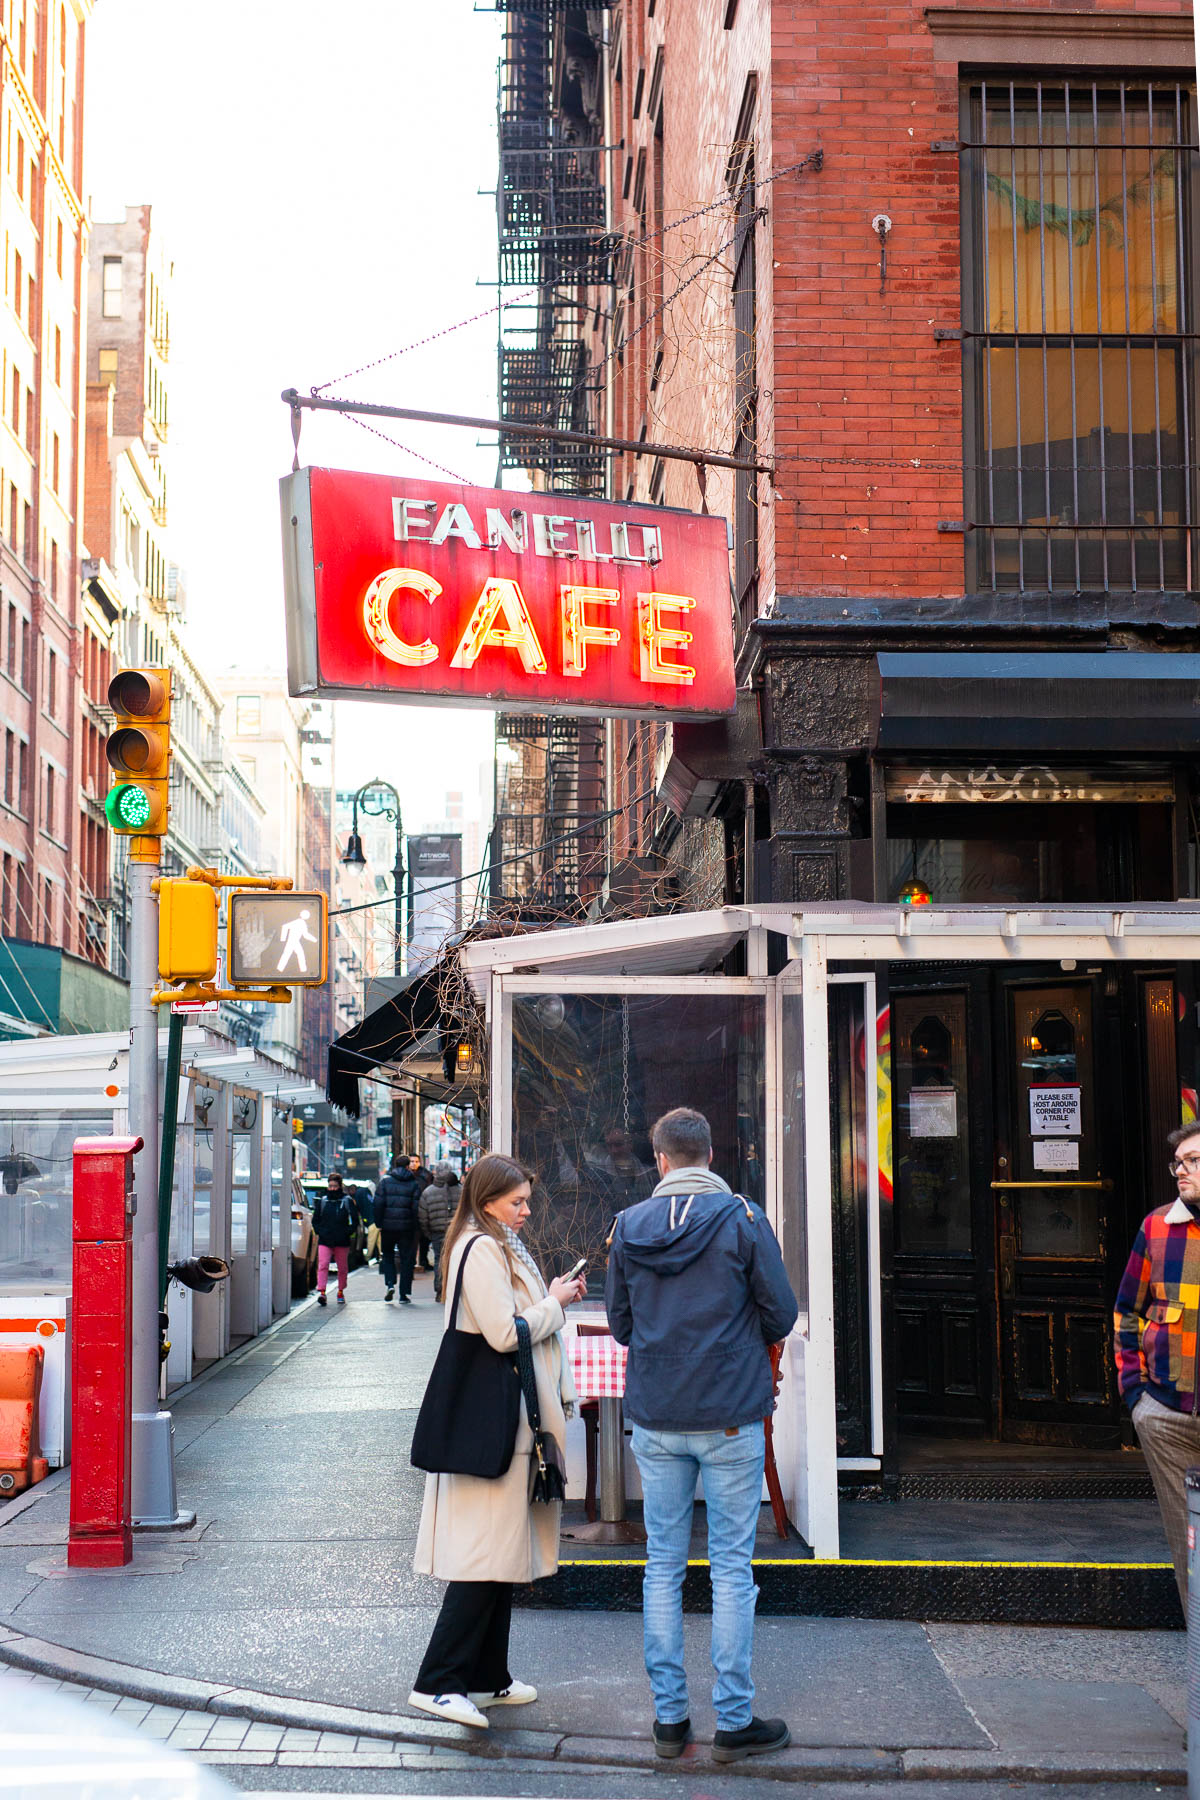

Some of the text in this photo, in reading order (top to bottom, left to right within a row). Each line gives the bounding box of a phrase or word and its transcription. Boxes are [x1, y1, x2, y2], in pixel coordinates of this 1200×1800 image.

[391, 496, 663, 567] FANELLI
[363, 567, 697, 686] CAFE
[1046, 1149, 1067, 1160] STOP
